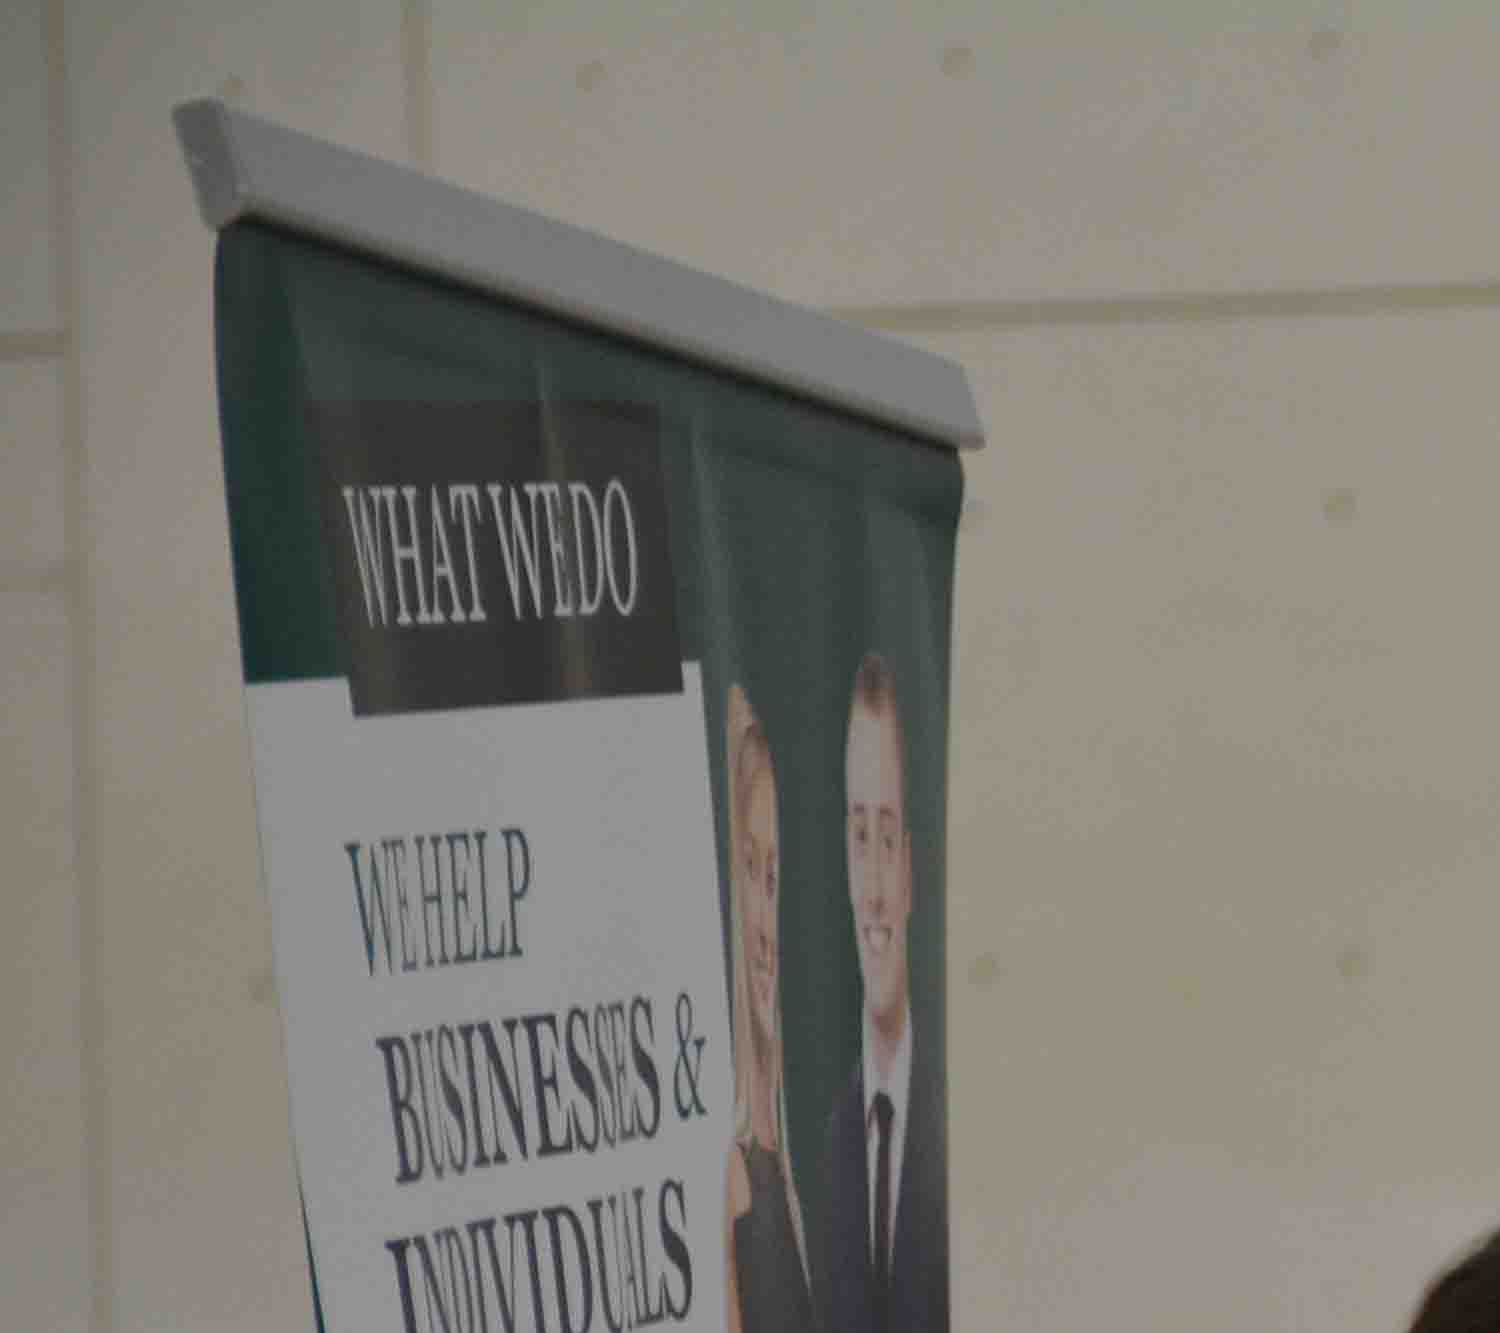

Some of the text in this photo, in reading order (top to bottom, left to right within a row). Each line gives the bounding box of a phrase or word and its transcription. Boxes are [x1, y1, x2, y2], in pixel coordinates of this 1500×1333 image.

[341, 484, 487, 627] WHAT
[375, 991, 708, 1185] BUSINESSES &
